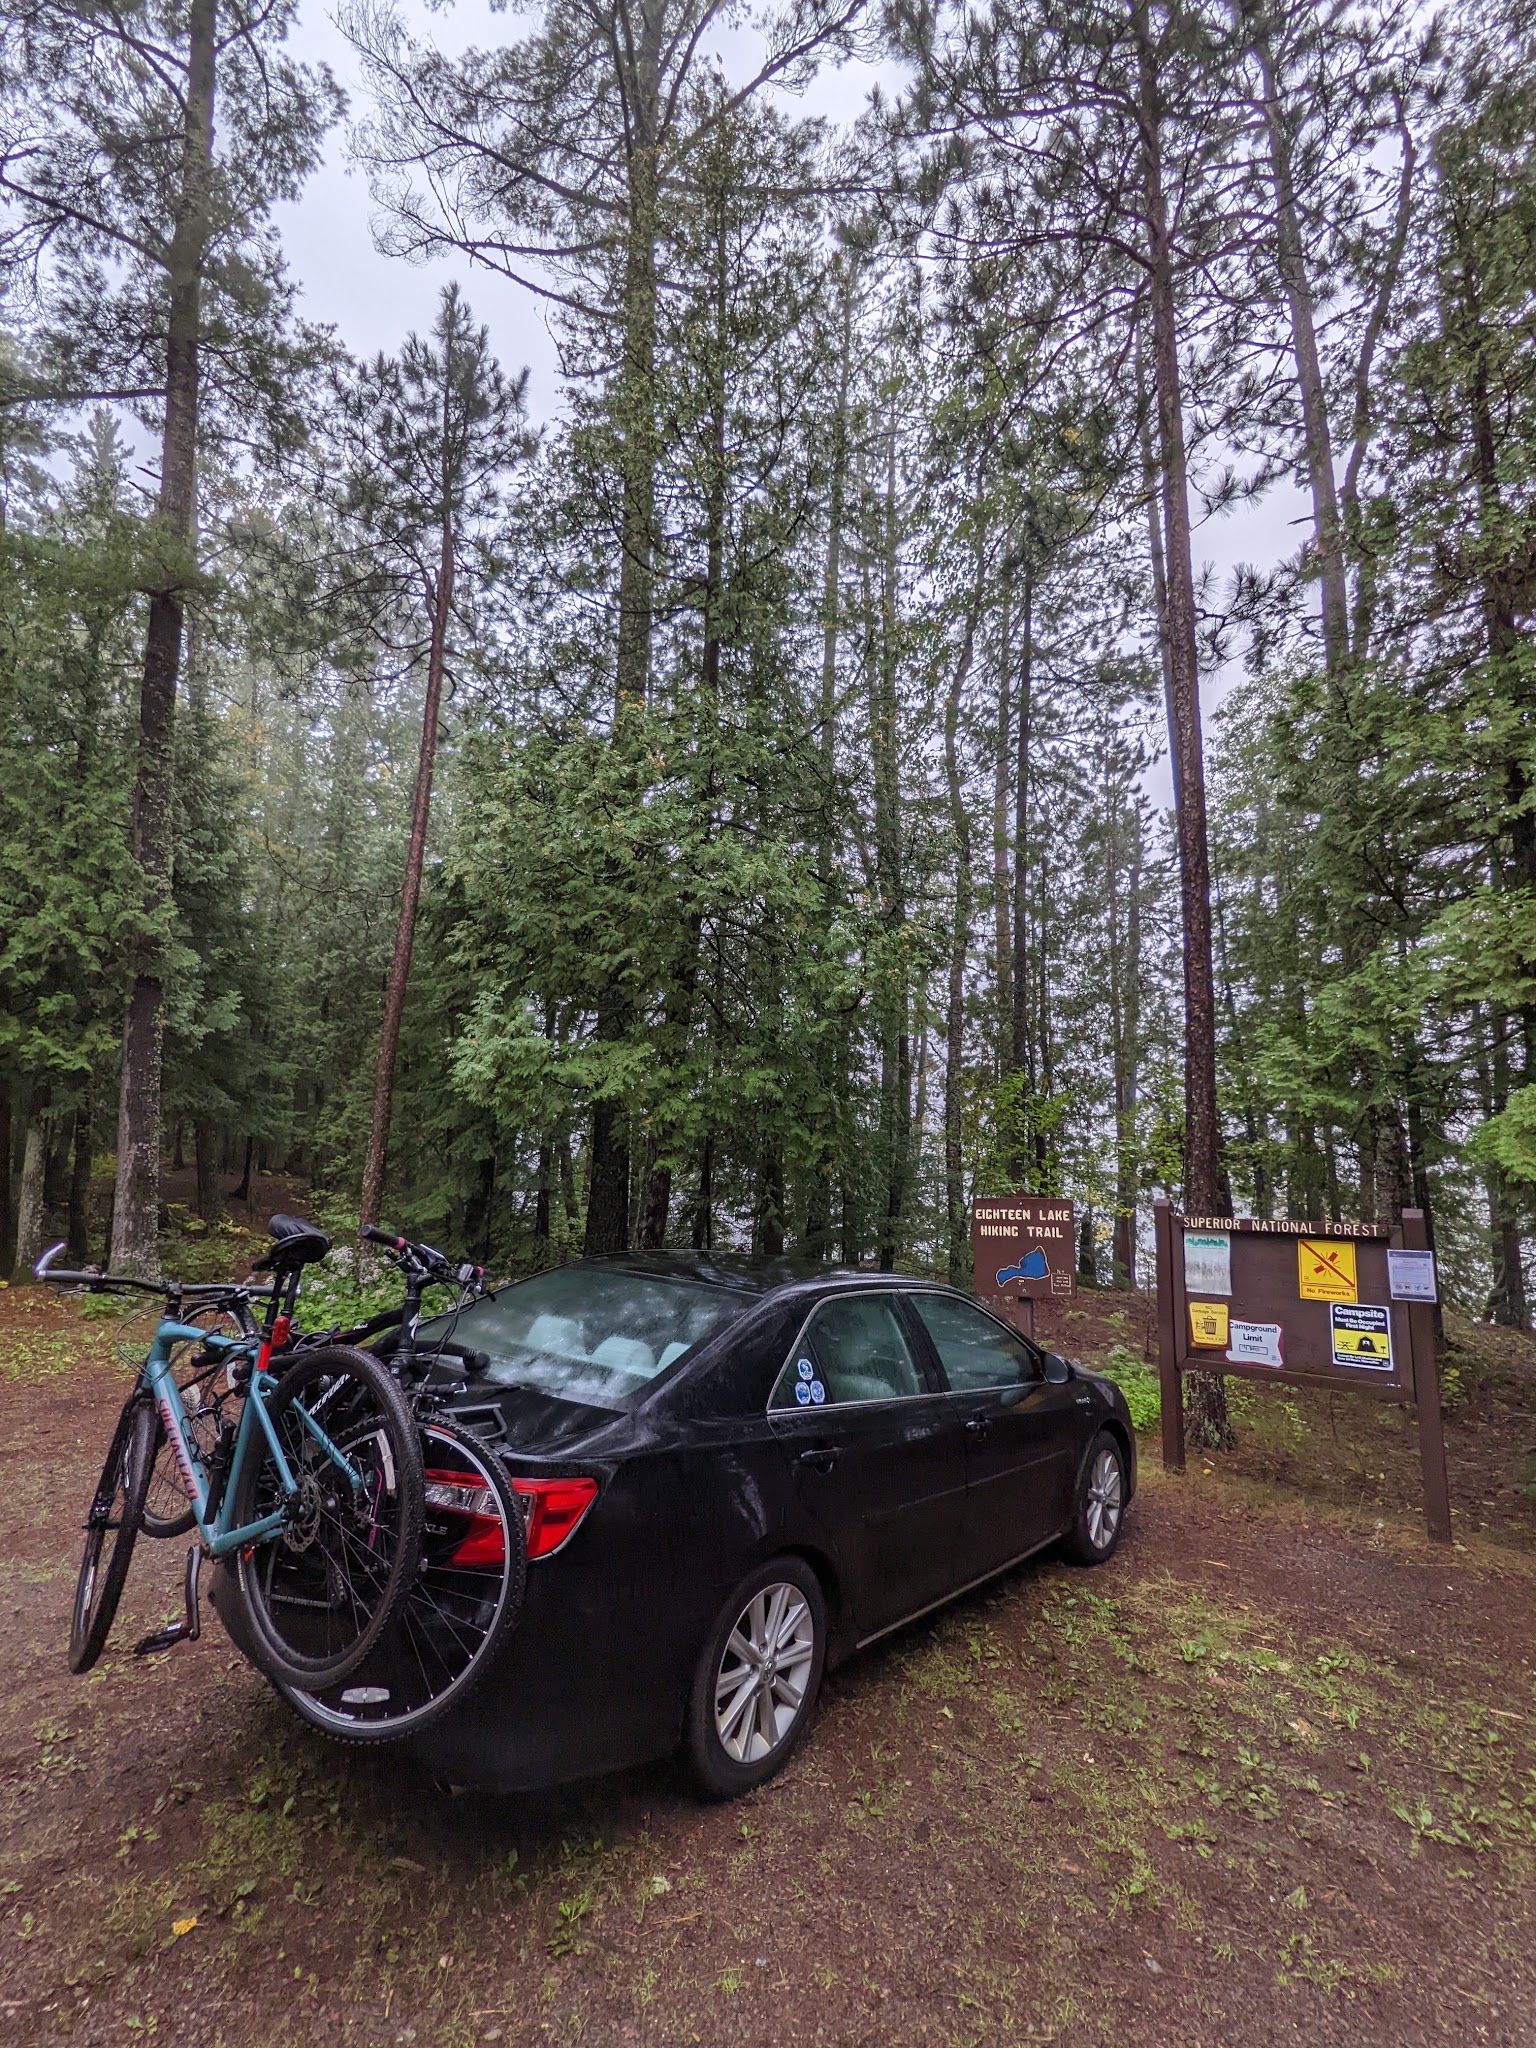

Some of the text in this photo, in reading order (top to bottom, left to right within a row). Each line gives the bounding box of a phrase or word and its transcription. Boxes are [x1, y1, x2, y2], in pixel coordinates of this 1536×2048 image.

[975, 1209, 1070, 1221] EIGHTEEN LAKE
[980, 1225, 1064, 1238] HIKING TRAIL
[1183, 1217, 1379, 1237] SUPERIOR NATIONAL FOREST
[1318, 1288, 1350, 1297] Fireworks
[1334, 1306, 1385, 1319] Campsite
[1229, 1321, 1277, 1334] Campground
[1358, 1319, 1386, 1327] Occupied
[1359, 1323, 1375, 1331] Night
[1243, 1333, 1263, 1343] Limit
[157, 1398, 199, 1501] SPECIALIZED
